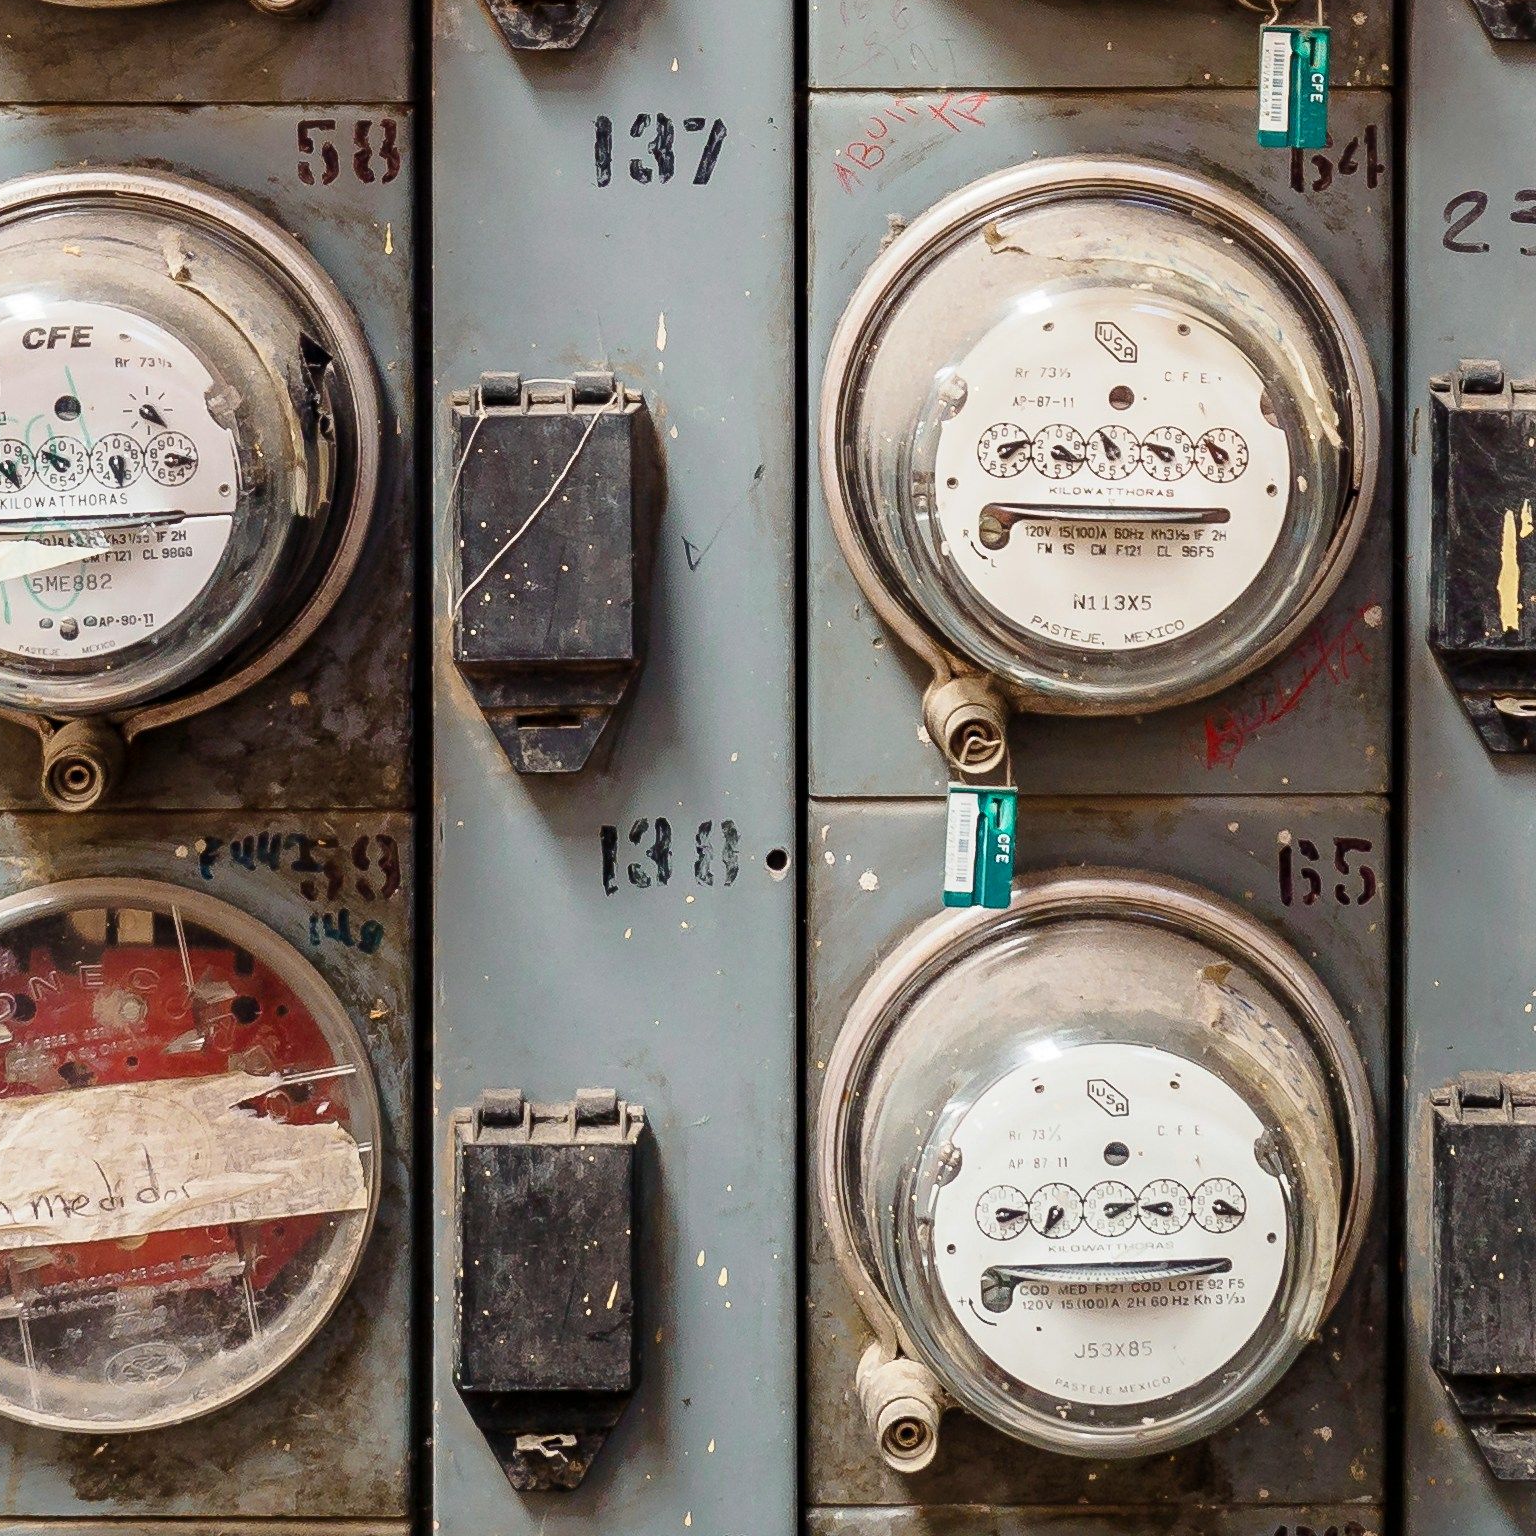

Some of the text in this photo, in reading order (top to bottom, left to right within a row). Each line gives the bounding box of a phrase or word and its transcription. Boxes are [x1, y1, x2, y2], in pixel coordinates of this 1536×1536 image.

[296, 119, 399, 186] 58
[595, 113, 727, 188] 137
[21, 325, 95, 351] CFE
[1097, 325, 1137, 360] IUSA
[0, 492, 129, 510] KILOWATTHORAS
[1124, 619, 1185, 644] MEXICO
[600, 816, 739, 896] 138
[1277, 838, 1376, 907] 65
[1089, 1082, 1126, 1115] IUSA
[1074, 1341, 1153, 1359] J53X85
